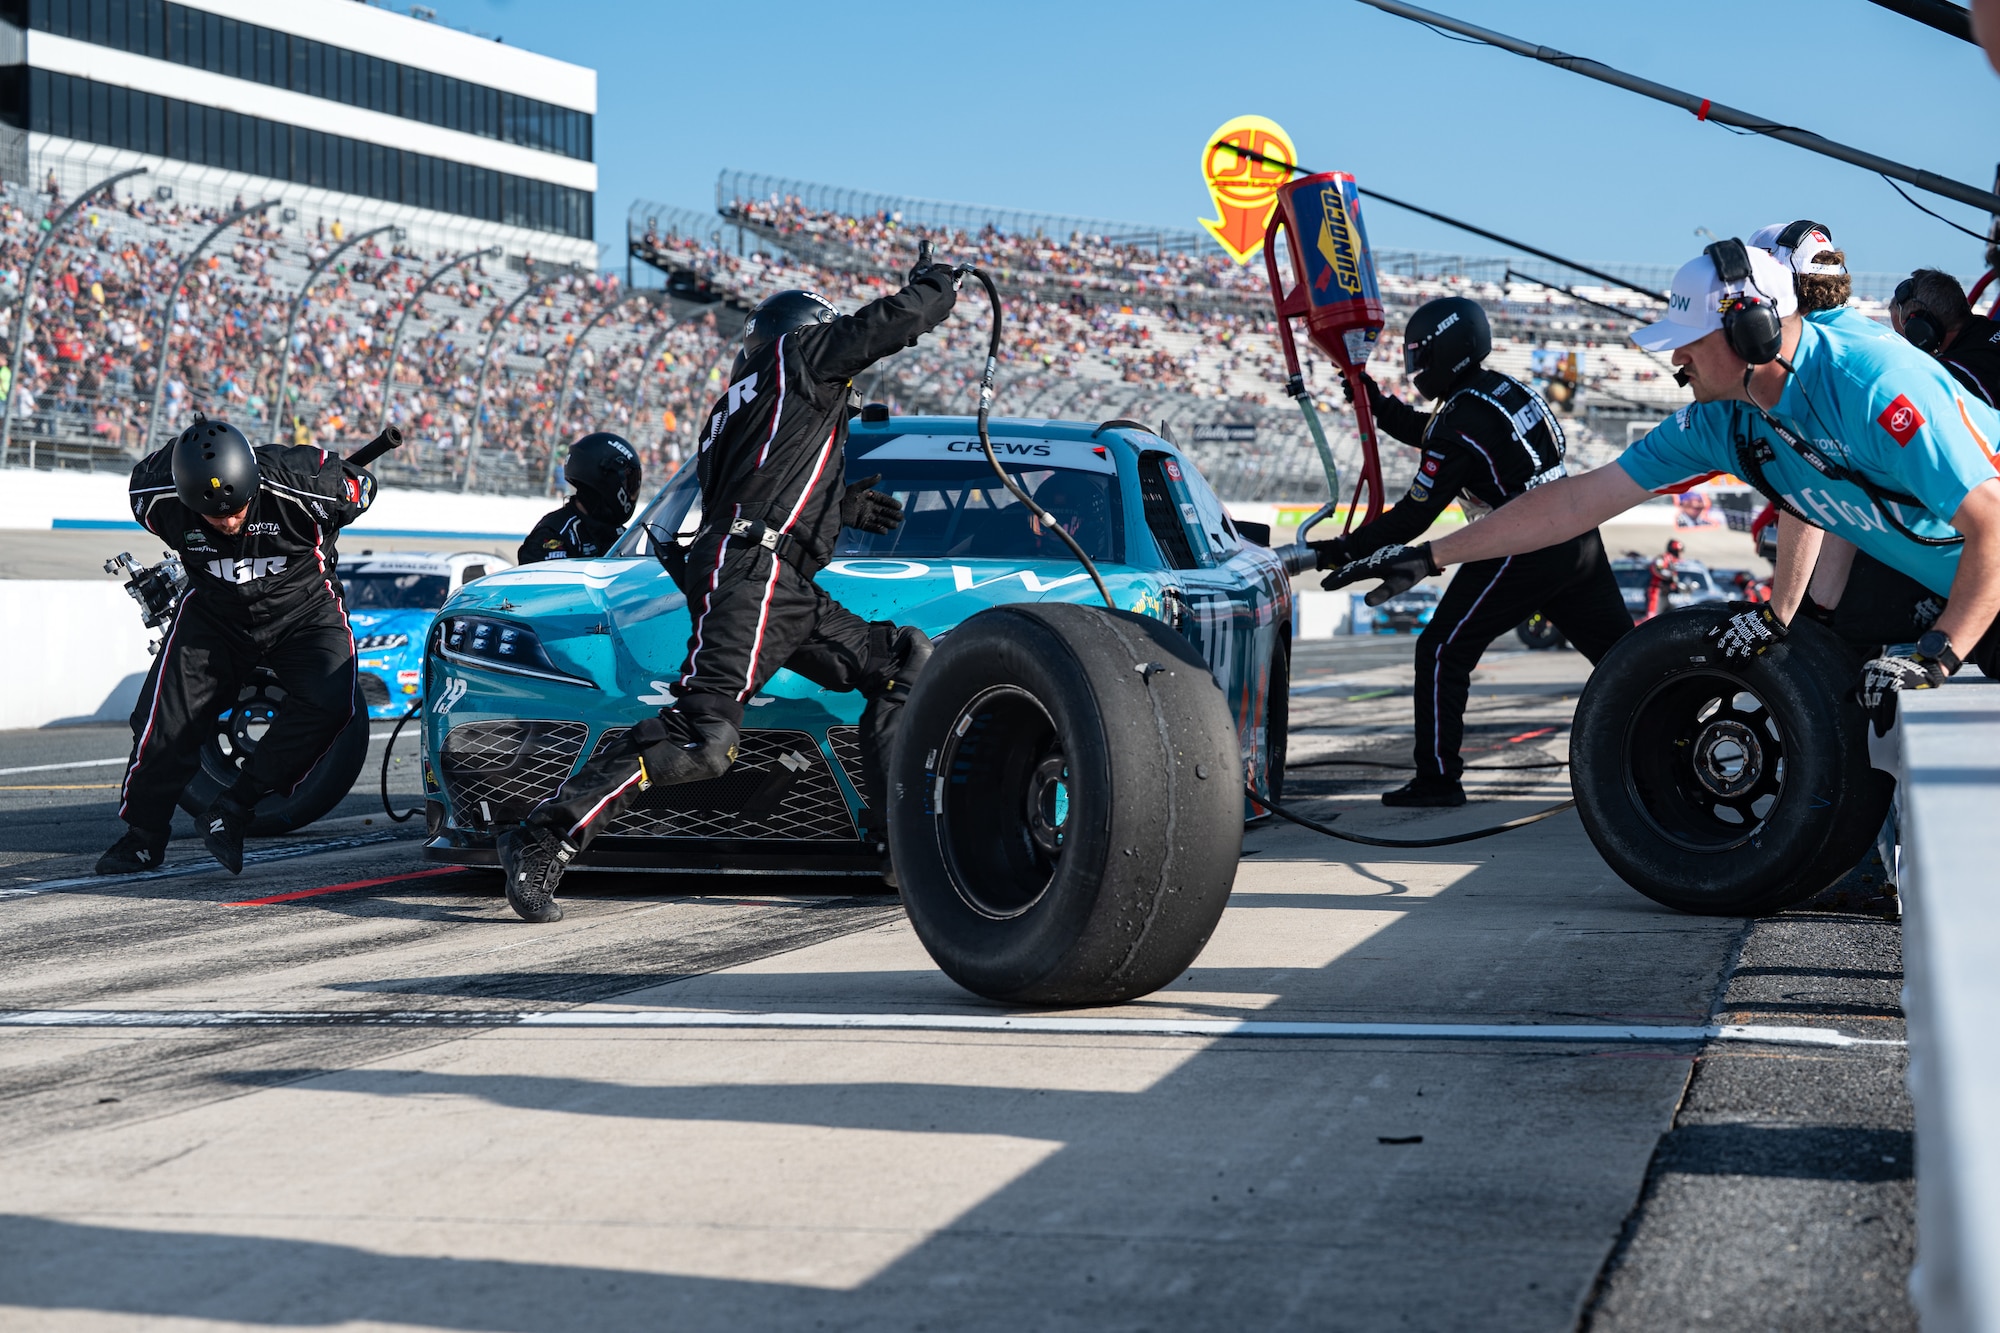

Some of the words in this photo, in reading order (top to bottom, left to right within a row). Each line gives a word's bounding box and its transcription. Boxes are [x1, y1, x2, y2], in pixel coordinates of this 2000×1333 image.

[1324, 190, 1360, 292] SUNOCO
[1435, 312, 1460, 336] JGR
[1452, 357, 1471, 373] VIPER
[702, 372, 758, 453] JR
[608, 440, 633, 460] JGR
[946, 440, 1051, 457] CREWS
[544, 550, 568, 560] JGR
[204, 556, 288, 584] JGR
